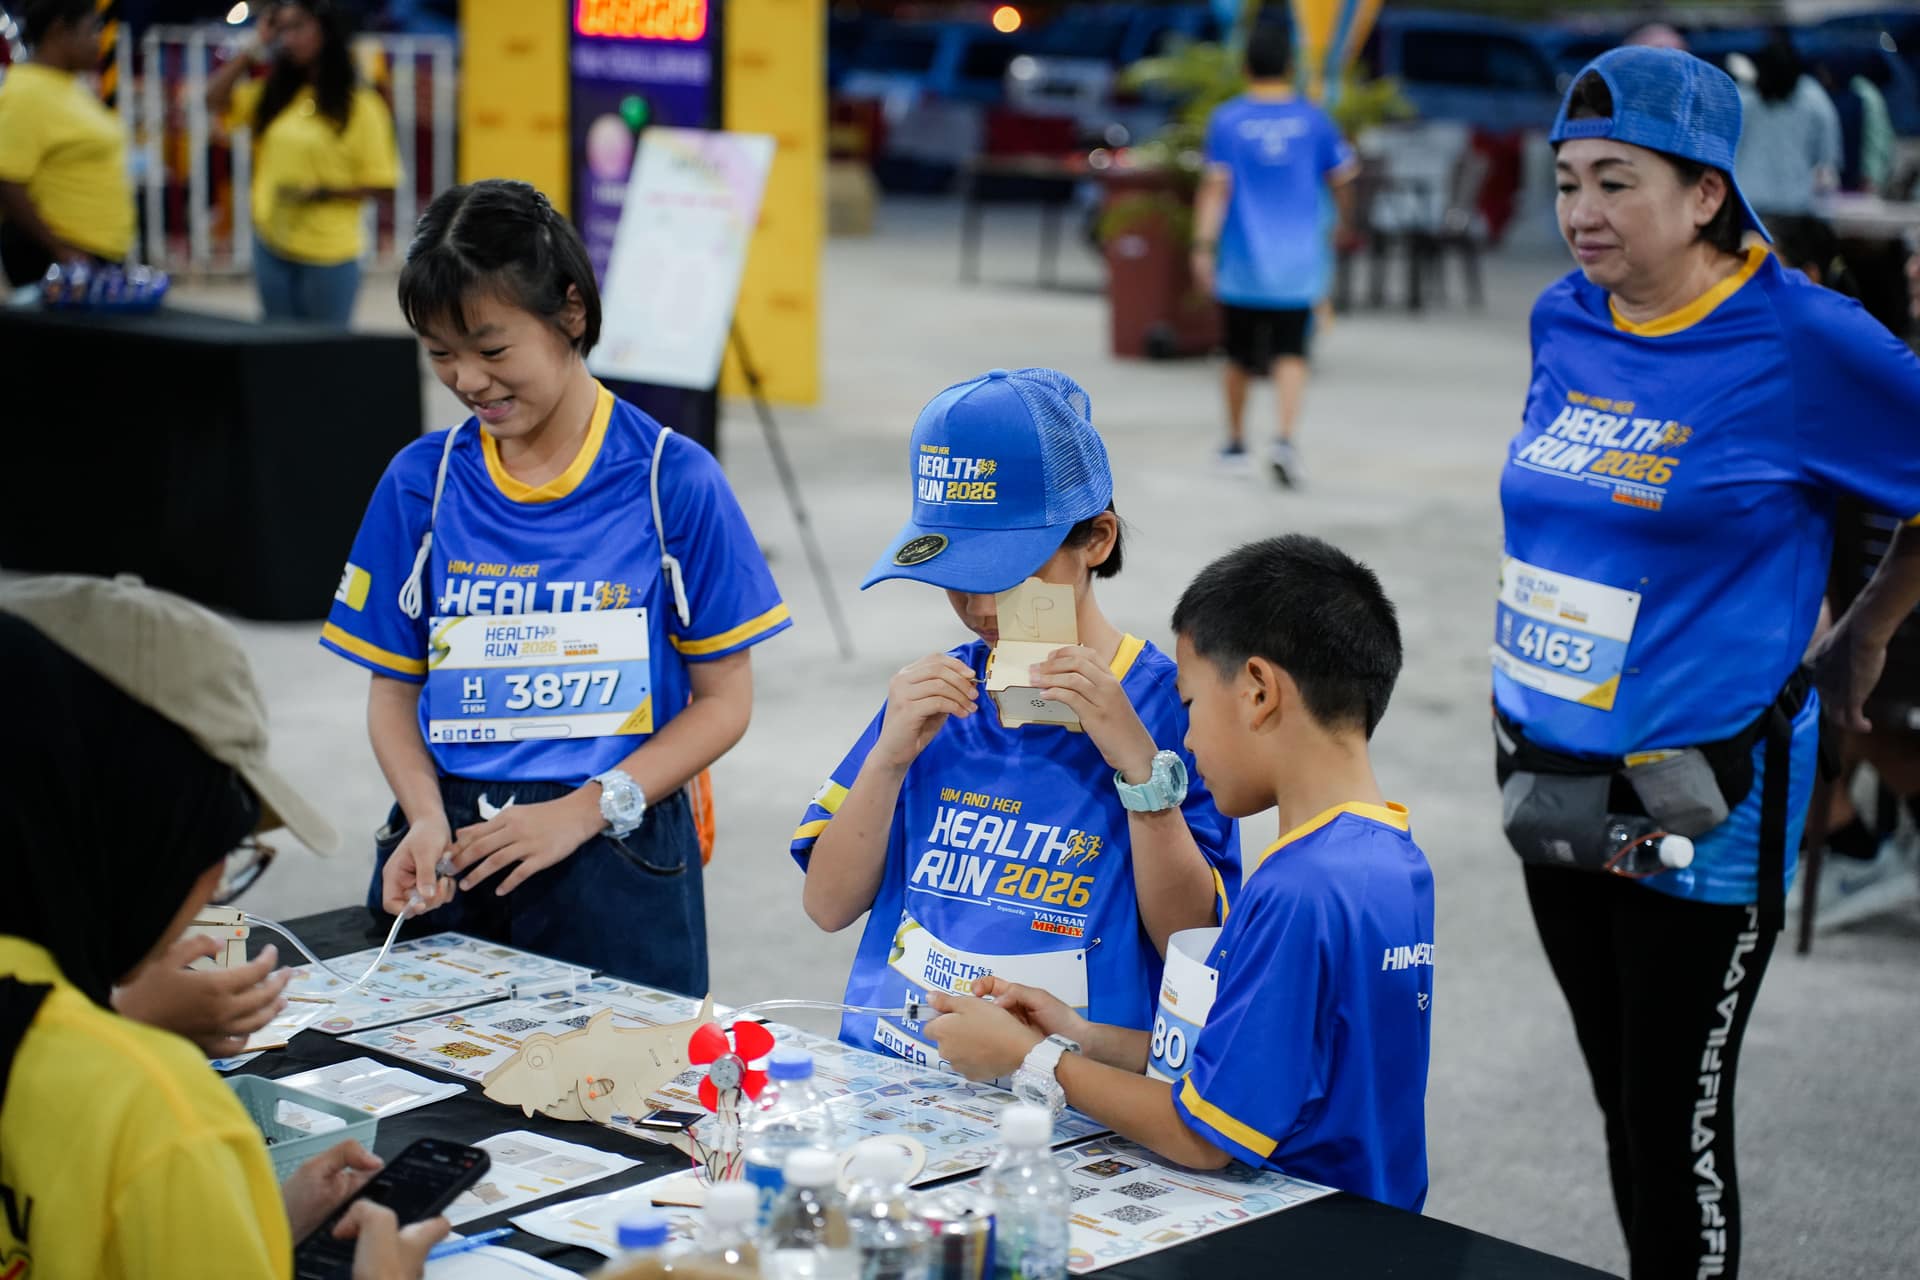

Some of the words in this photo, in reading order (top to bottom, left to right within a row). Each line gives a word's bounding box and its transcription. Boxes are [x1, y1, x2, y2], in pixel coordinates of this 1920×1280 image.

[1546, 406, 1676, 452] HEALTH
[918, 455, 985, 480] HEALTH
[1517, 434, 1602, 473] RUN
[1590, 449, 1680, 485] 2026
[918, 477, 944, 502] RUN
[946, 481, 997, 500] 2026
[448, 560, 474, 574] HIM
[475, 563, 507, 576] AND
[509, 564, 539, 577] HER
[441, 578, 605, 616] HEALTH
[485, 625, 548, 641] HEALTH
[485, 643, 518, 657] RUN
[1517, 622, 1595, 673] 4163
[463, 676, 483, 699] H
[504, 670, 620, 711] 3877
[940, 787, 961, 803] HIM
[962, 791, 990, 809] AND
[992, 798, 1023, 815] HER
[928, 806, 1079, 866] HEALTH
[911, 849, 996, 897] RUN
[995, 863, 1095, 909] 2026
[1034, 911, 1086, 927] YAYASAN
[923, 964, 952, 990] RUN
[954, 978, 973, 993] 20
[926, 948, 980, 980] HEALTH
[1151, 1014, 1188, 1068] 80
[1697, 1228, 1727, 1280] FIL
